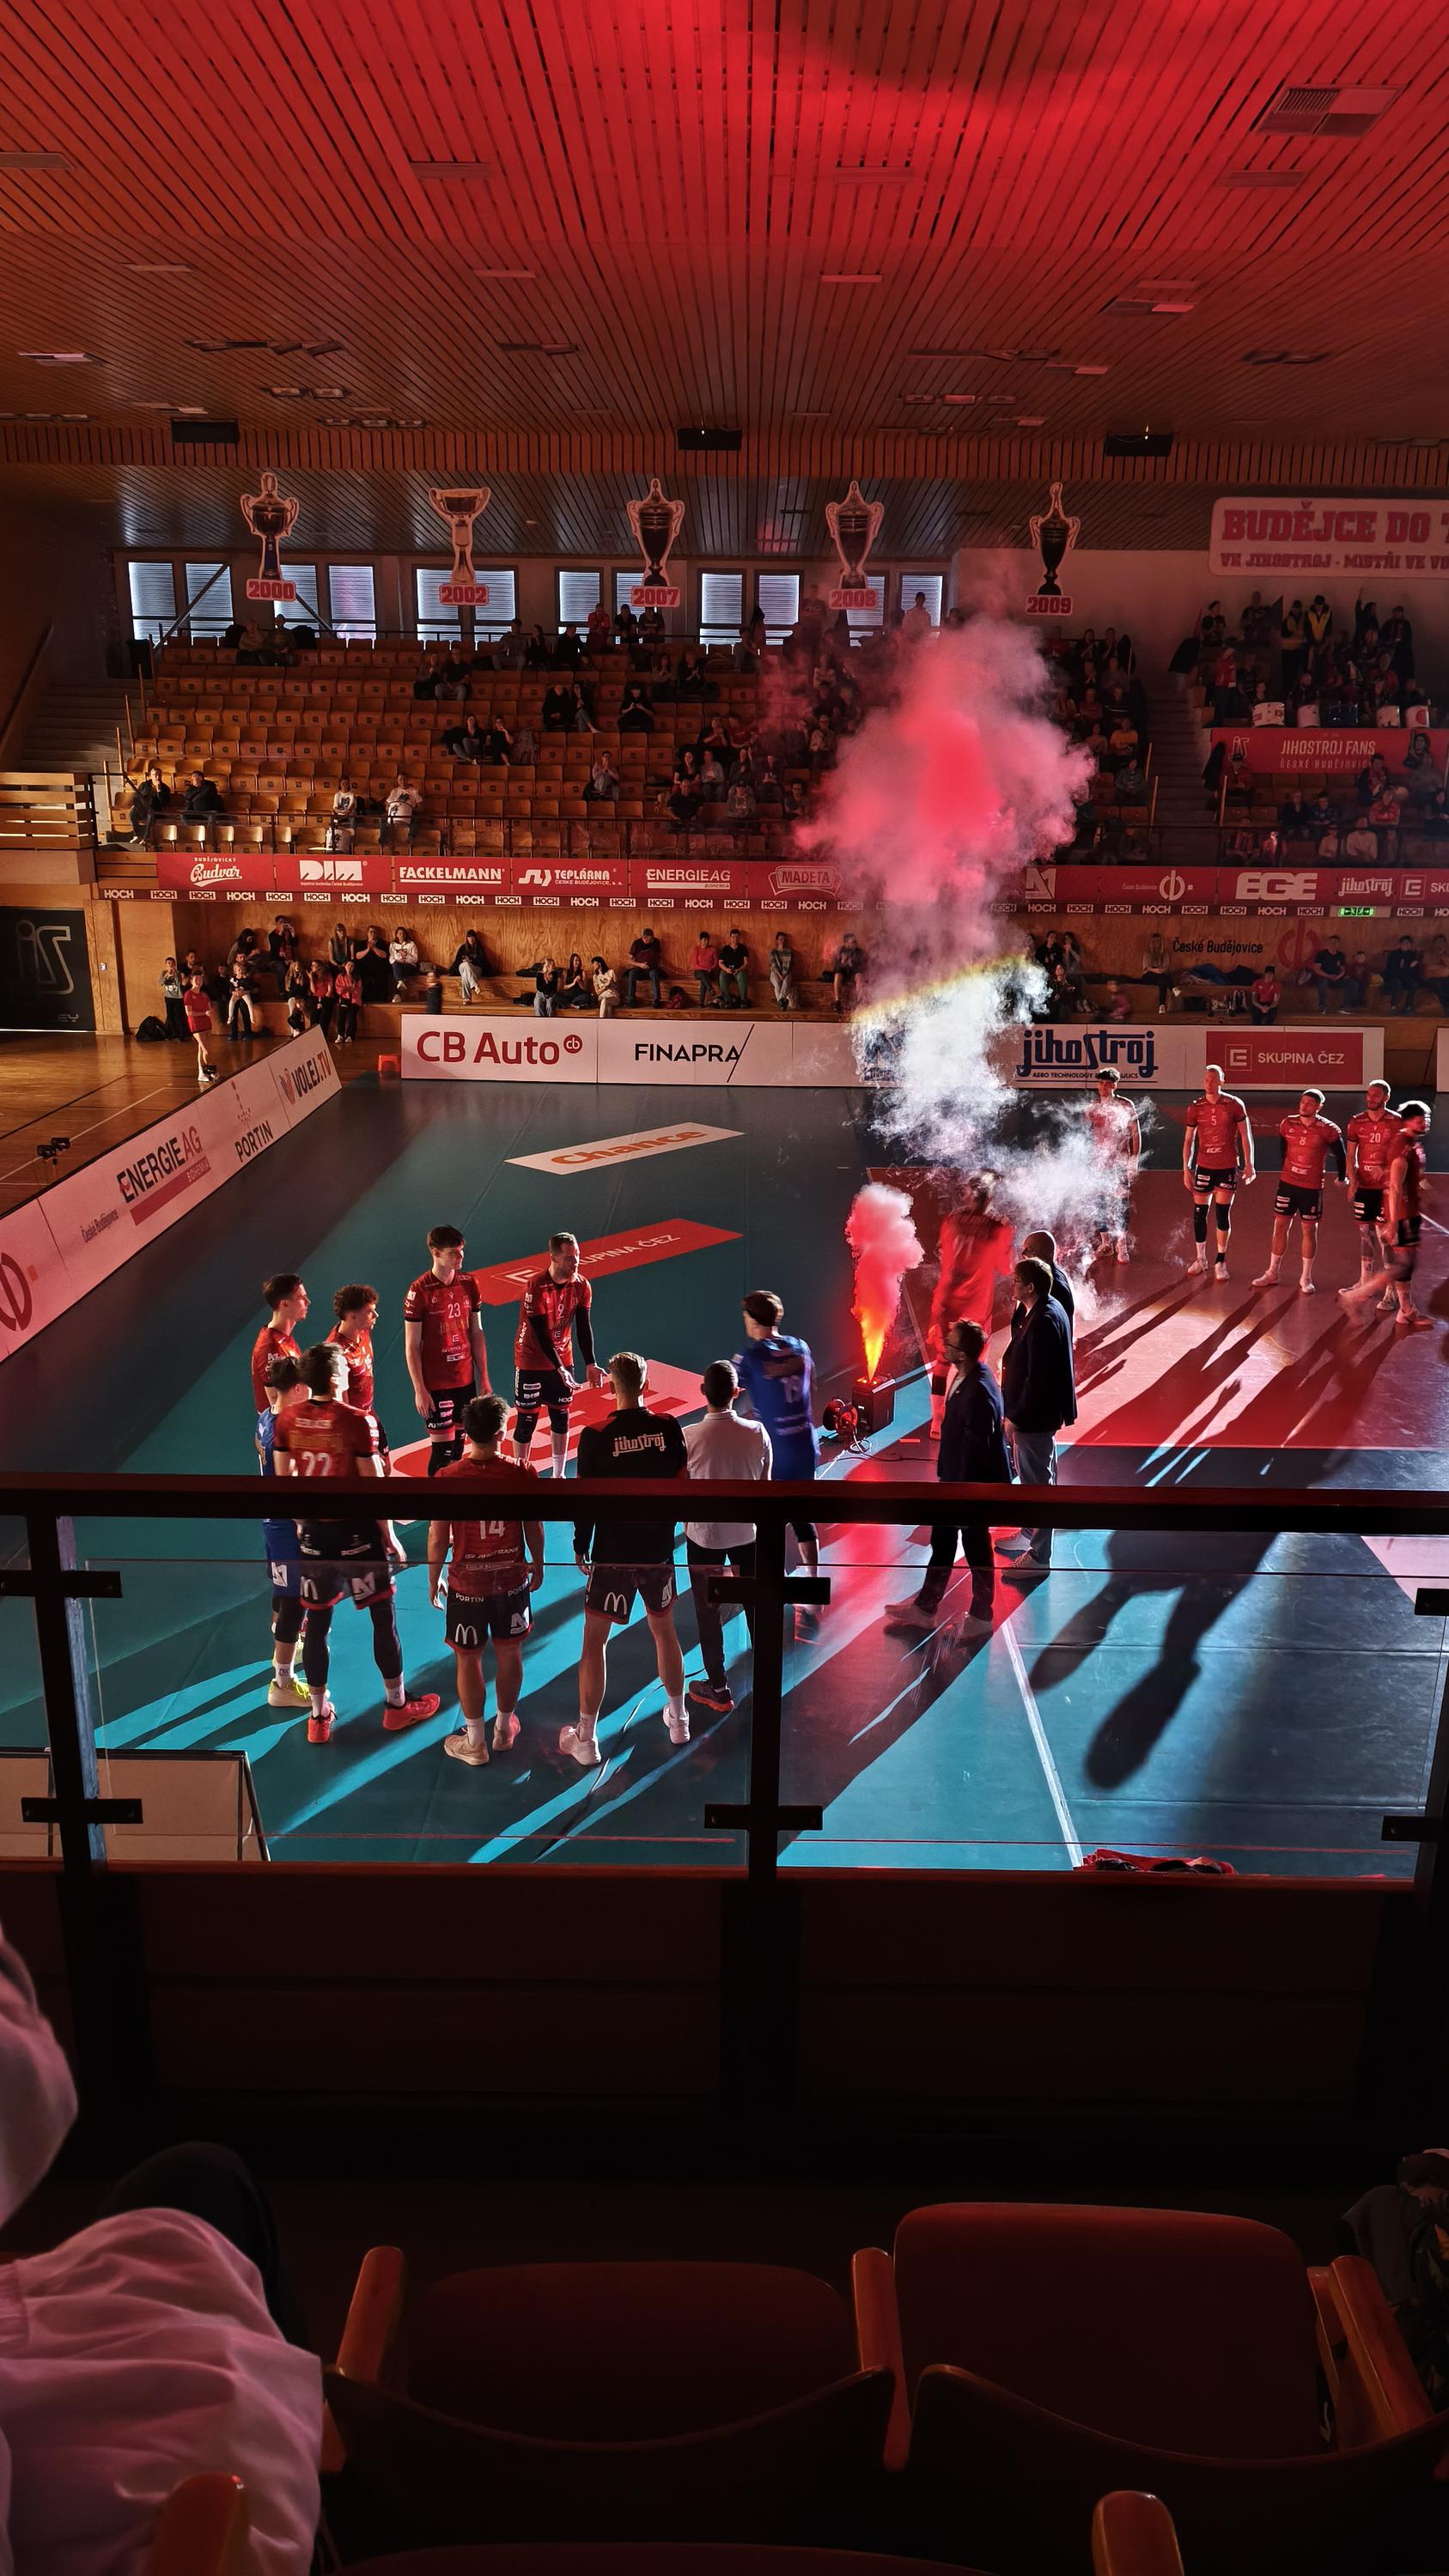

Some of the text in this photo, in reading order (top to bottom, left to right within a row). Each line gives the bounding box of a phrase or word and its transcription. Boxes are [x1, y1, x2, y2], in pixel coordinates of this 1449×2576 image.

[1221, 501, 1378, 543] BUDĚJCE
[1385, 512, 1431, 544] DO
[1245, 553, 1332, 568] JIHOSTROJ
[247, 580, 295, 600] 2000
[441, 586, 487, 604] 2002
[634, 588, 679, 607] 2007
[830, 589, 878, 608] 2008
[1027, 596, 1073, 615] 2009
[1280, 739, 1376, 756] JIHOSTROJ FANS
[190, 863, 243, 885] Budvar
[399, 866, 502, 880] FACKELMANN
[554, 868, 610, 880] TEPLÁRNA
[781, 870, 830, 884] MADETA
[1235, 872, 1318, 901] EGE
[104, 890, 134, 899] HOCH
[227, 891, 255, 901] HOCH
[342, 893, 370, 902] HOCH
[456, 896, 484, 905] HOCH
[570, 897, 600, 907] HOCH
[685, 900, 713, 908] HOCH
[799, 901, 827, 910] HOCH
[1027, 903, 1056, 913] HOCH
[1142, 905, 1171, 914] HOCH
[1258, 907, 1287, 915] HOCH
[1172, 937, 1263, 956] České Budějovice
[417, 1030, 560, 1065] CB Auto
[635, 1043, 740, 1062] FINAPRA
[1016, 1030, 1159, 1078] jihostroj
[1257, 1052, 1315, 1064] SKUPINA
[1318, 1050, 1345, 1065] ČEZ
[291, 1049, 332, 1097] VOLEJ.TV
[1211, 1115, 1217, 1126] 5
[234, 1120, 274, 1163] PORTIN
[551, 1131, 708, 1164] Chance
[1300, 1136, 1306, 1145] 8
[1369, 1133, 1381, 1144] 20
[638, 1234, 681, 1249] ČEZ
[447, 1302, 461, 1319] 23
[557, 1303, 564, 1315] 9
[612, 1431, 667, 1457] jihostroj
[455, 1592, 484, 1603] PORTIN
